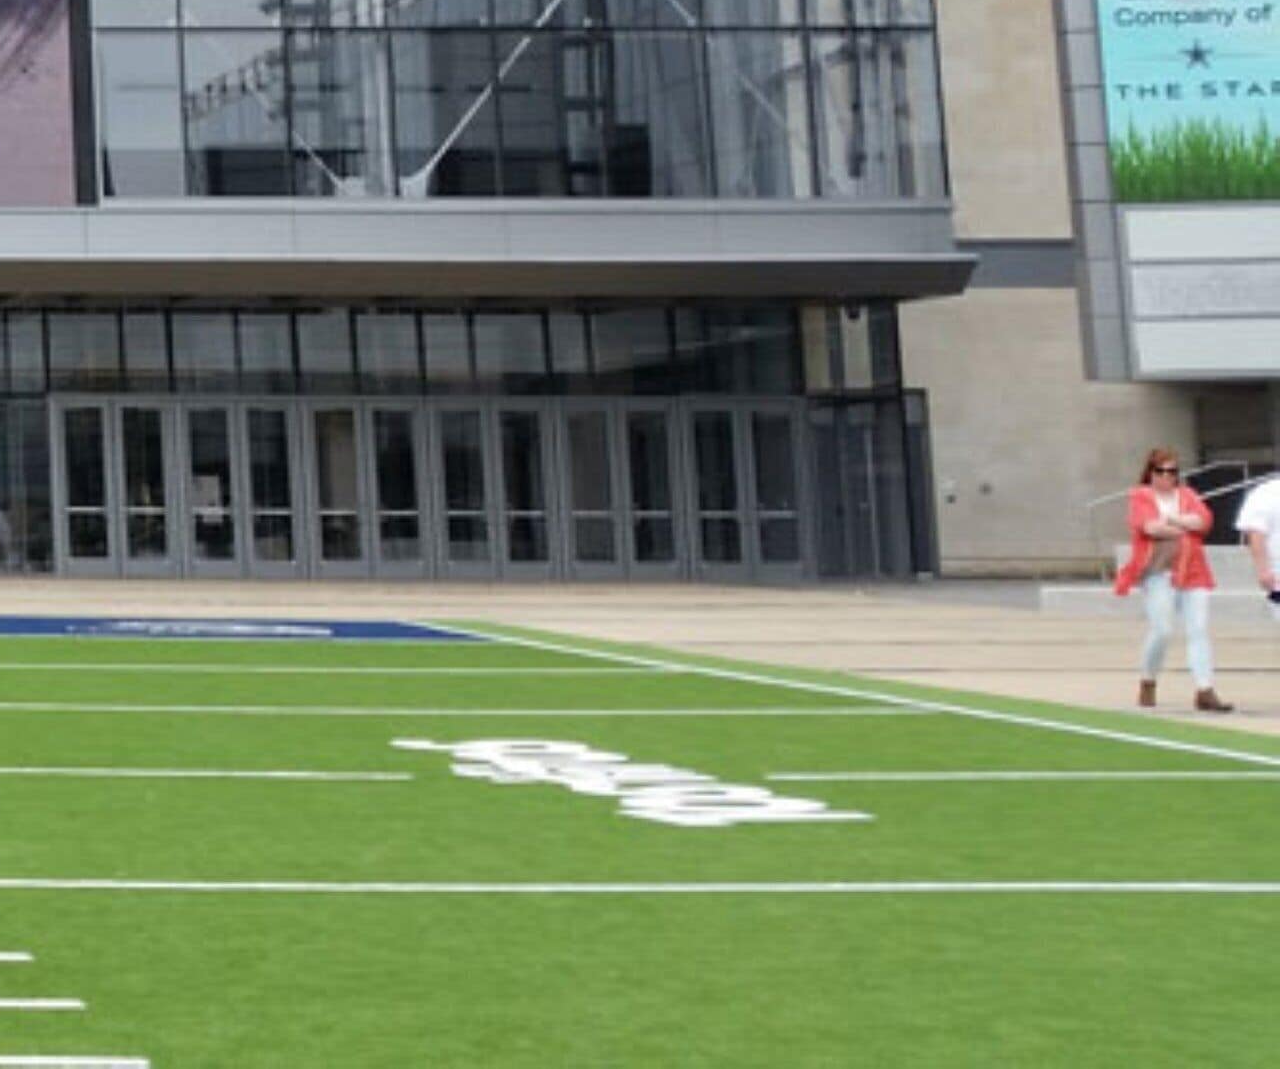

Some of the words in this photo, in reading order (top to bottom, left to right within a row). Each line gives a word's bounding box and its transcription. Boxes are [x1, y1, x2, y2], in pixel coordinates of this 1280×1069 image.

[1114, 6, 1236, 26] Company
[1245, 2, 1272, 22] of
[1115, 82, 1181, 100] THE
